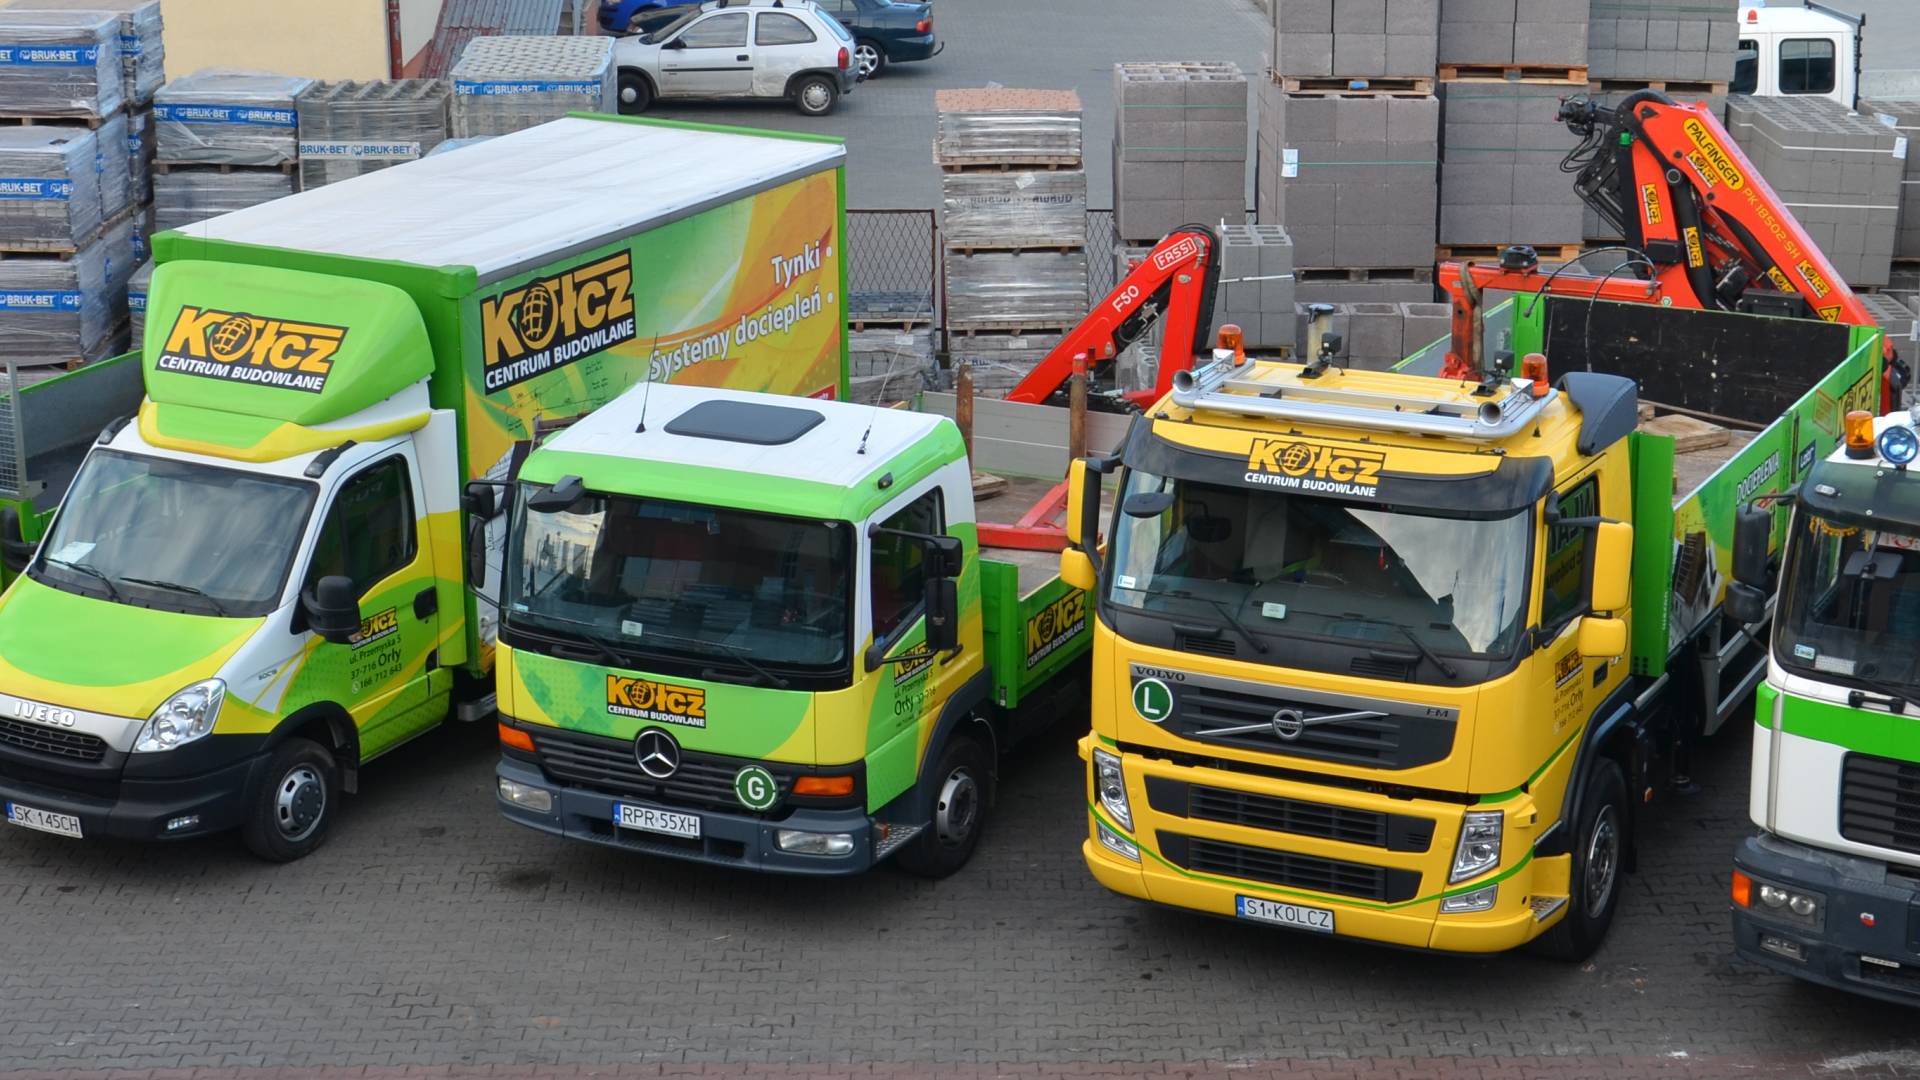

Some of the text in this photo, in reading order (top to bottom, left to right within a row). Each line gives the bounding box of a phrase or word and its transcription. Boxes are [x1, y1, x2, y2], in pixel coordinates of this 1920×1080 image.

[31, 50, 77, 60] BRUK-BET
[186, 107, 292, 121] BRUK-BET BRUK-BET
[300, 145, 411, 154] BRUK-BET BRUK-BET
[1687, 122, 1740, 187] PALFINGER
[0, 183, 42, 193] RUK-BET
[1742, 188, 1758, 206] PK
[771, 240, 821, 288] Tynki
[1157, 241, 1193, 267] FASSI
[8, 294, 54, 305] BRUK-BET
[1112, 285, 1139, 313] F50
[650, 285, 822, 383] Systemy dociepleń
[486, 319, 635, 389] CENTRUM BUDOWLANE
[159, 355, 325, 390] CENTRUM BUDOWLANE
[1244, 472, 1377, 497] CENTRUM BUDOWLANE
[1135, 666, 1186, 682] VOLVO
[1144, 686, 1160, 715] L
[14, 701, 76, 728] IVECO
[608, 705, 705, 727] CENTRUM BUDOWLANE
[747, 776, 765, 801] G
[14, 806, 80, 833] SK 145CH
[623, 806, 698, 834] RPR 55XH
[1274, 903, 1330, 928] KOLCZ
